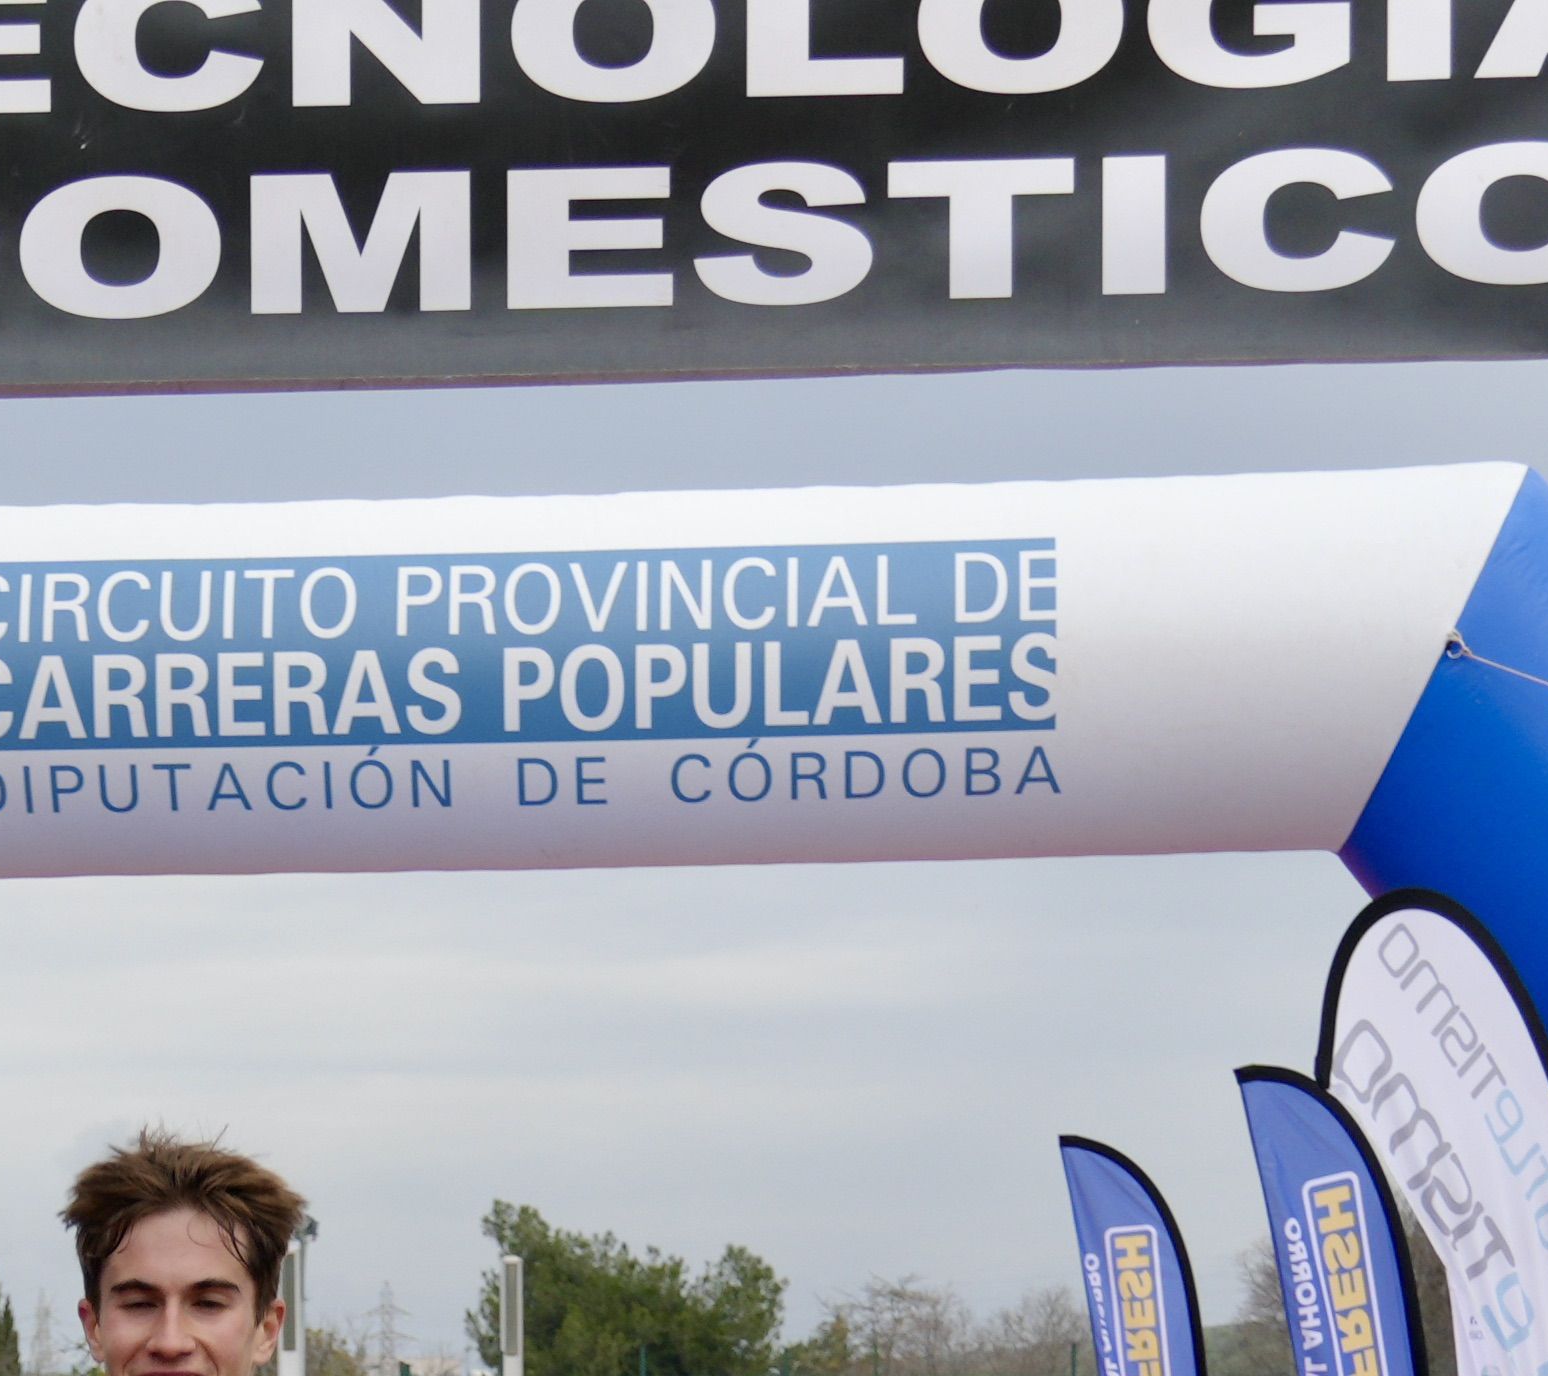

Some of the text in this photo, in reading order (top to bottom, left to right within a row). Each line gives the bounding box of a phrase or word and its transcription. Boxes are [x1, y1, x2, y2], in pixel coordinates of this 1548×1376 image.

[395, 553, 892, 636] PROVINCIAL
[954, 549, 1059, 622] DE
[504, 633, 1061, 732] POPULARES
[515, 756, 609, 806] DE
[671, 738, 1062, 803] CÓRDOBA
